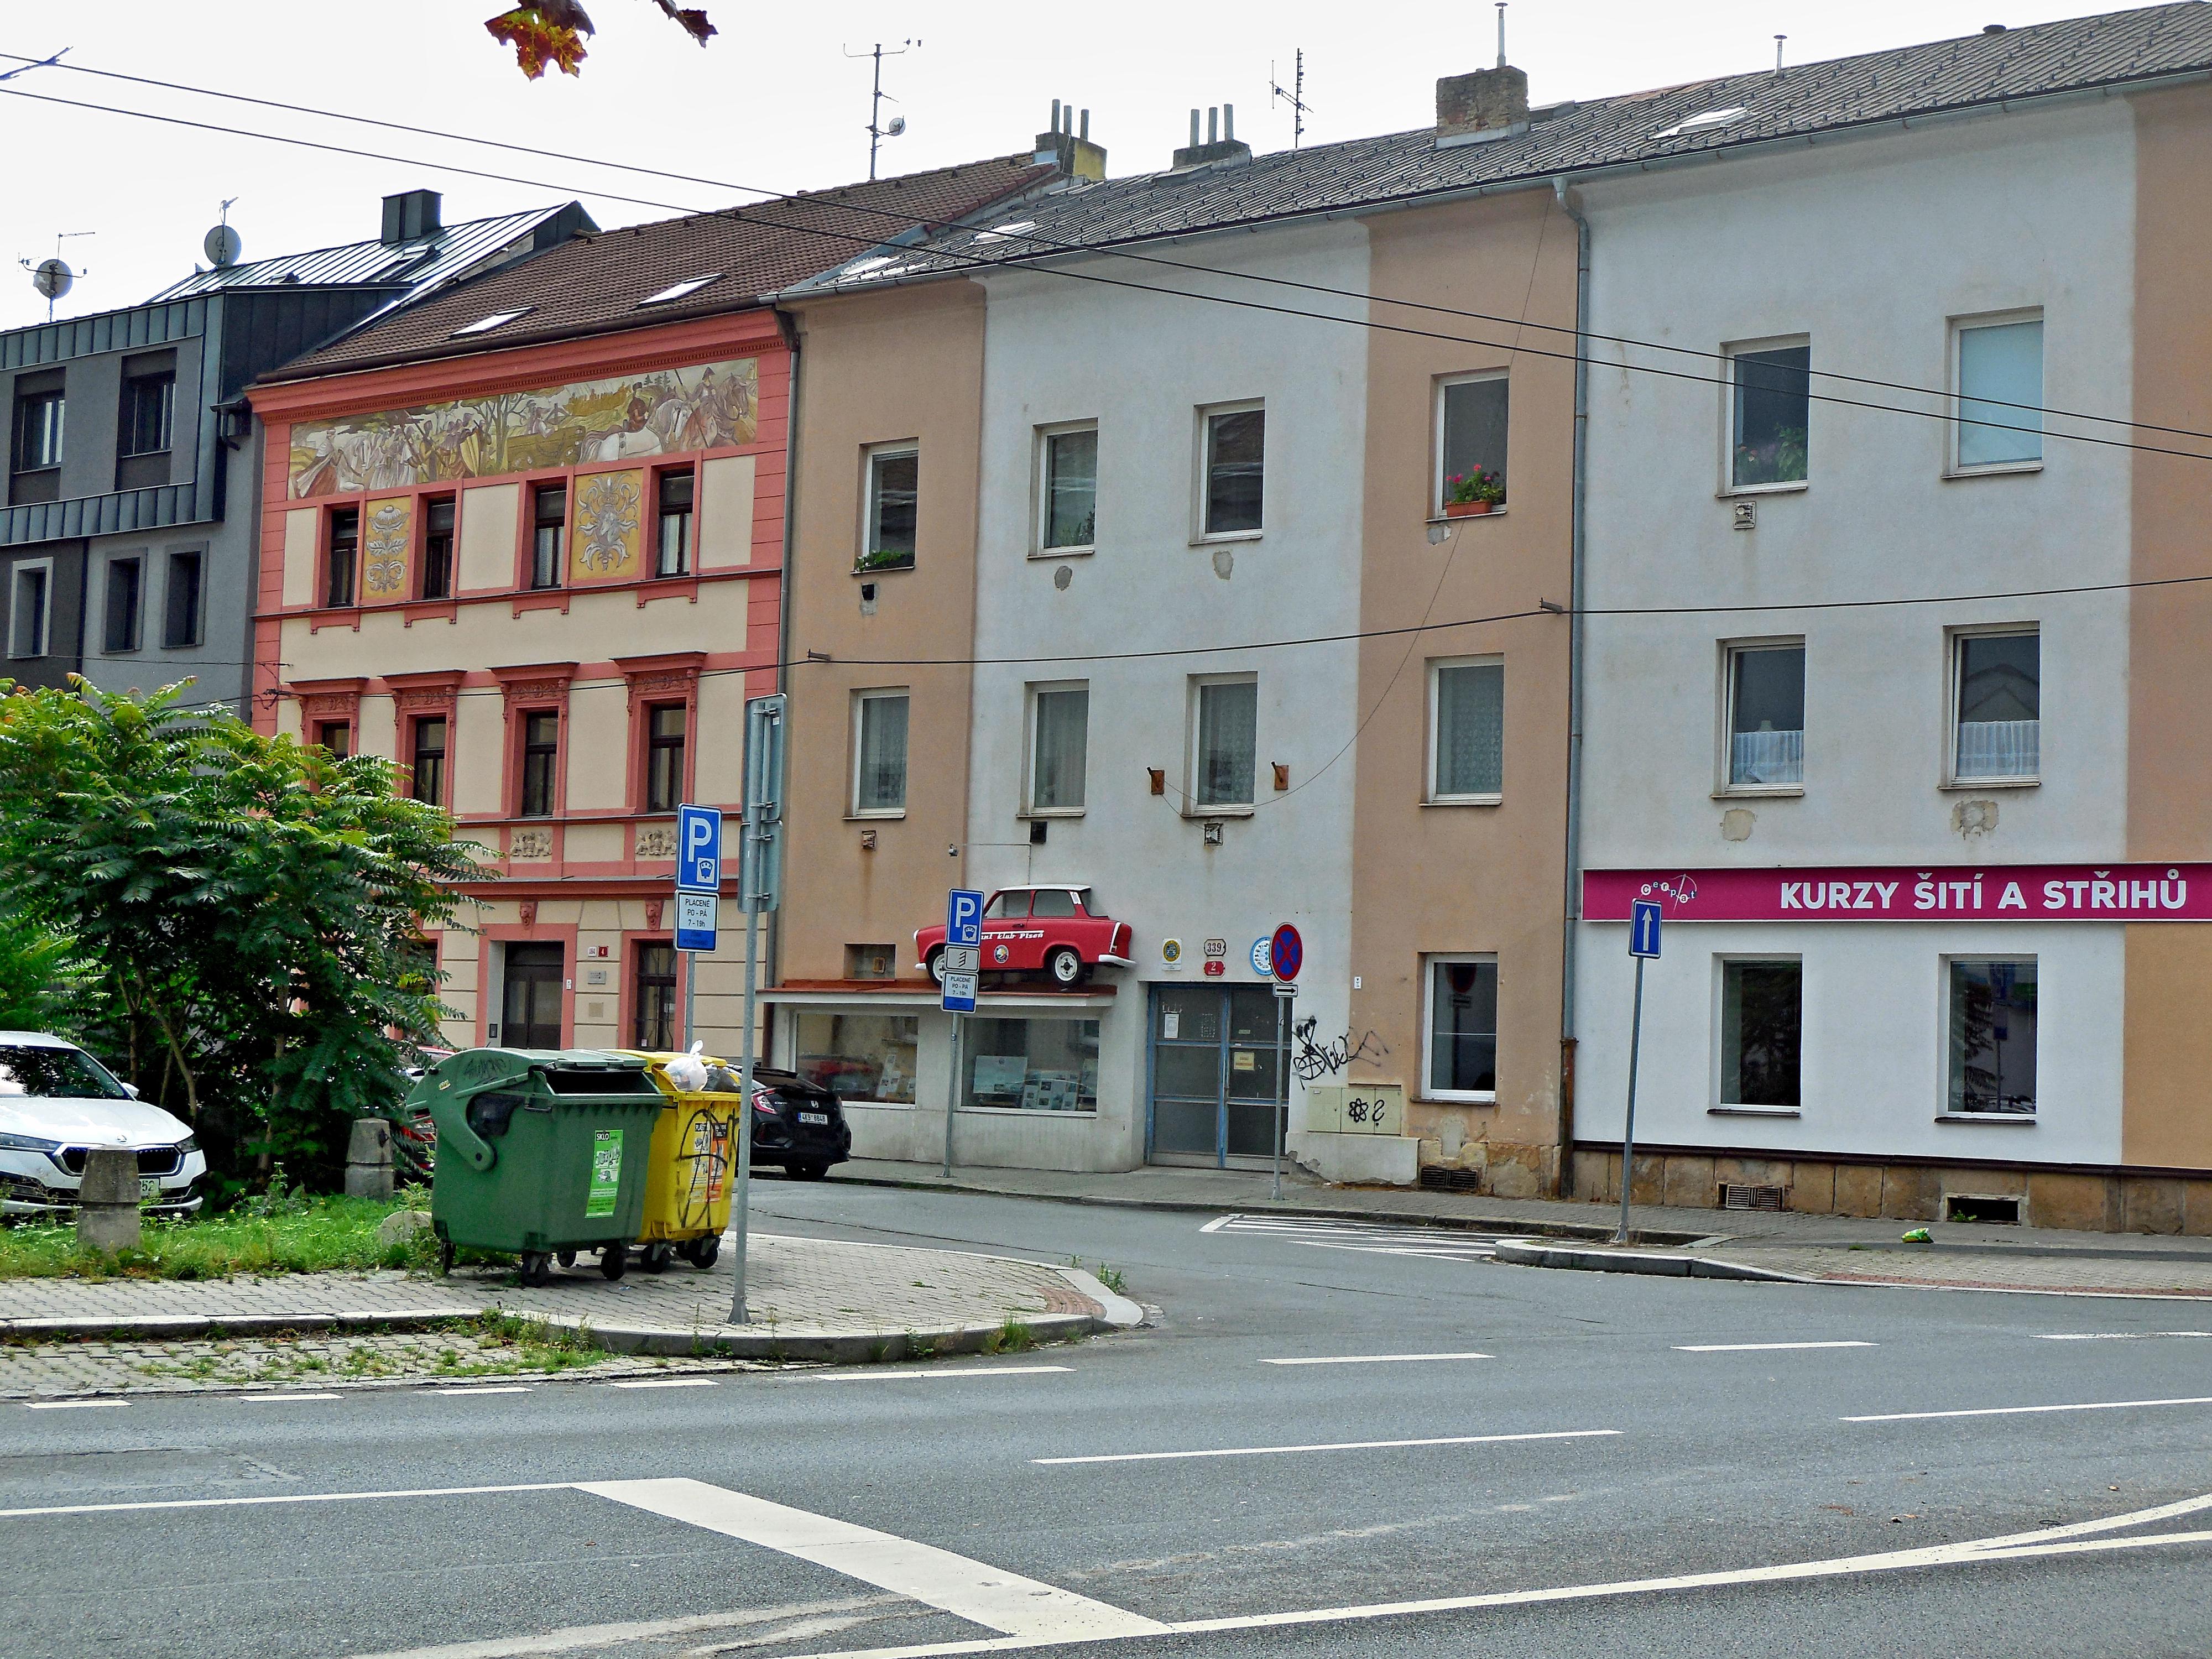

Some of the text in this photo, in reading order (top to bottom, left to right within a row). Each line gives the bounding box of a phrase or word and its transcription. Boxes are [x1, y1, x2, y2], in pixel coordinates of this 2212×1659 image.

[687, 817, 712, 862] P
[1781, 869, 2187, 910] KURZY ŠITÍ A STŘIHŮ
[685, 898, 710, 907] PLACENÉ
[700, 908, 707, 917] PÁ
[955, 897, 975, 928] P
[1207, 942, 1222, 953] 339
[1211, 961, 1216, 971] 2
